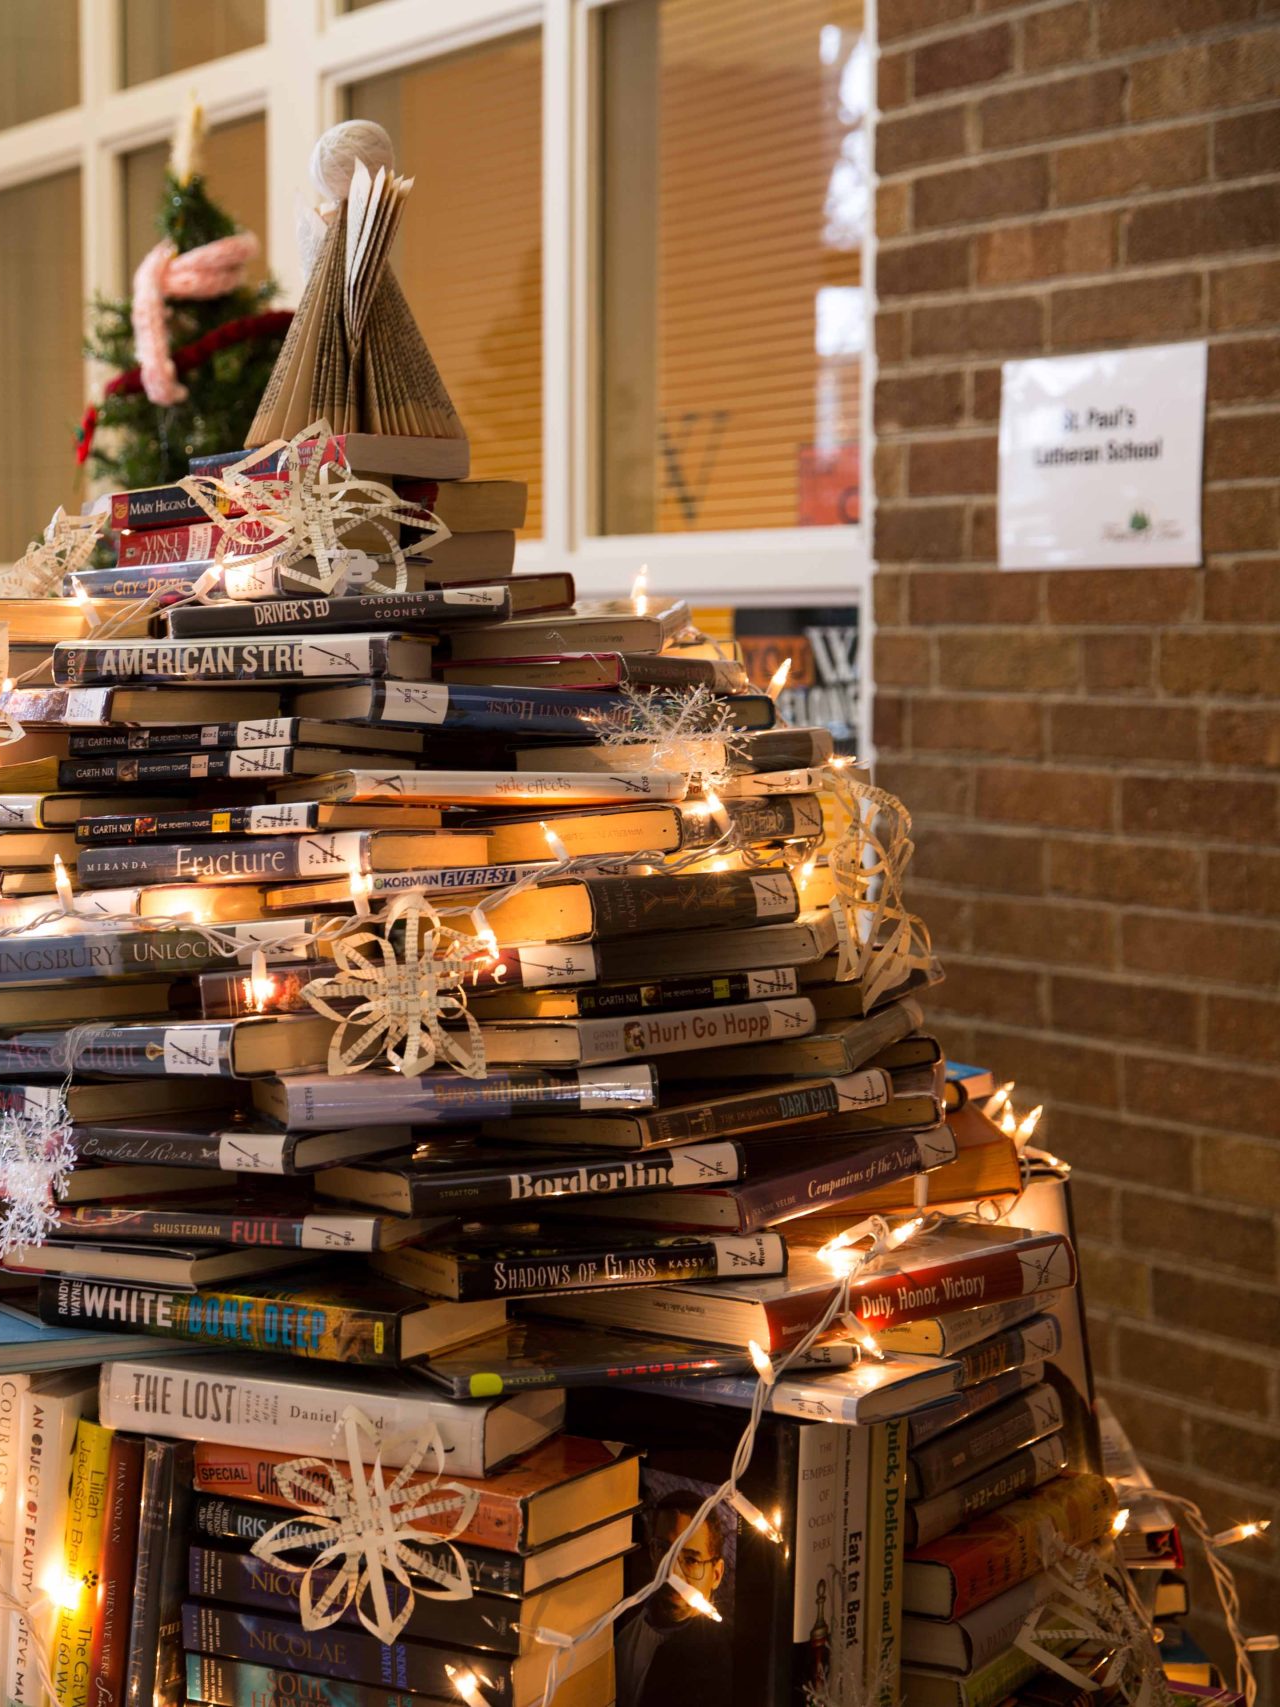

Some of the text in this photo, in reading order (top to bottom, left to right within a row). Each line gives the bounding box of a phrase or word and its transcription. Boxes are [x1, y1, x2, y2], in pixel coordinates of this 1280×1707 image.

[130, 496, 187, 516] MARY HIGGINS
[144, 531, 181, 551] VINCE
[139, 550, 182, 566] FLYNN
[113, 580, 139, 597] CITY
[360, 594, 424, 607] CAROLINE
[254, 599, 330, 627] DRIVER'S ED
[375, 608, 427, 620] COONEY
[66, 643, 304, 683] ZOBO AMERICAN STRE
[486, 699, 535, 721] HOUSE
[88, 737, 112, 748] GARTH
[113, 736, 126, 747] NIX
[76, 768, 101, 779] GARTH
[101, 767, 114, 777] NIX
[495, 776, 524, 794] side
[92, 825, 118, 835] GARTH
[119, 824, 132, 834] NIX
[86, 860, 148, 872] MIRANDA
[175, 848, 286, 877] Fracture
[384, 867, 517, 889] KORMAN EVEREST
[133, 940, 233, 962] UNLOCKE
[647, 1020, 688, 1045] Hurt
[692, 1016, 718, 1039] Go
[723, 1012, 770, 1039] Happ
[304, 1086, 314, 1121] SHETH
[780, 1087, 838, 1119] DARK CALL
[82, 1137, 194, 1161] Crooked River
[807, 1169, 865, 1199] Companions
[865, 1163, 877, 1183] of
[877, 1157, 893, 1175] the
[892, 1148, 921, 1170] Nigh
[439, 1188, 479, 1199] STRATTON
[152, 1220, 283, 1245] SHUSTERMAN FULL
[494, 1253, 705, 1291] SHADOWS OF GLASS KASSY
[70, 1280, 82, 1318] WAYNE
[860, 1274, 986, 1320] Duty, Honor, Victory
[58, 1279, 326, 1350] RANDY WHITE BONE DEEP
[132, 1372, 238, 1425] THE LOST
[289, 1404, 339, 1424] Daniel
[73, 1439, 91, 1522] Jackson
[201, 1467, 248, 1481] SPECIAL
[21, 1404, 45, 1594] AN OBJECT OF BEAUTY
[87, 1469, 105, 1519] Lilian
[111, 1461, 127, 1544] HAN NOLAN
[237, 1514, 267, 1539] IRIS
[880, 1487, 899, 1598] Delicious,
[437, 1553, 486, 1583] ALEY
[105, 1580, 117, 1617] WHEN
[846, 1530, 862, 1649] Eat to Beat
[102, 1620, 114, 1640] WE
[881, 1601, 892, 1633] and
[57, 1642, 71, 1666] 60
[72, 1626, 93, 1689] The Cat
[100, 1644, 112, 1679] WERE
[249, 1631, 348, 1665] NICOLAE
[395, 1644, 408, 1689] JENKINS
